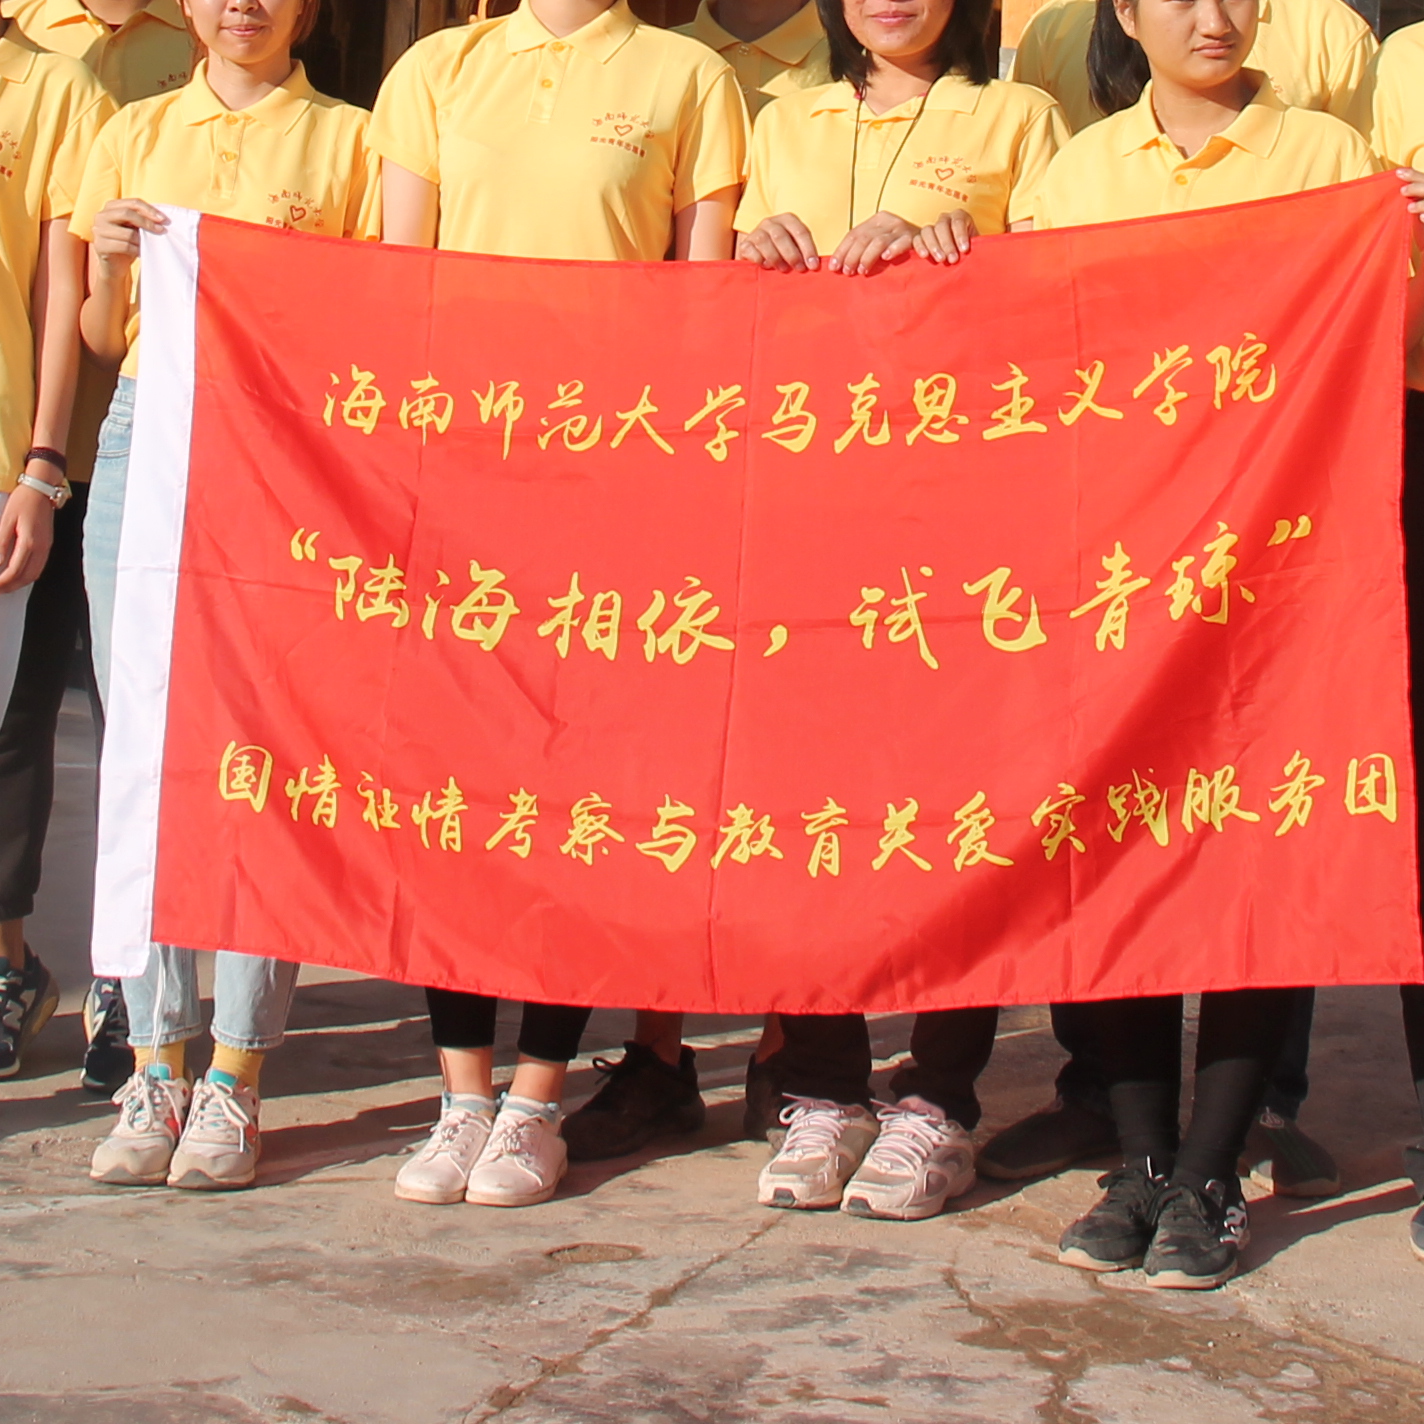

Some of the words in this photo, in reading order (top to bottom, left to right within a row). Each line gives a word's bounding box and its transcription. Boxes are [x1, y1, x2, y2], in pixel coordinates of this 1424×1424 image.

[322, 332, 1277, 462] 海南师范大学马克思主义学院
[218, 740, 1398, 878] 国情社情考察与教育关爱实践服务团
